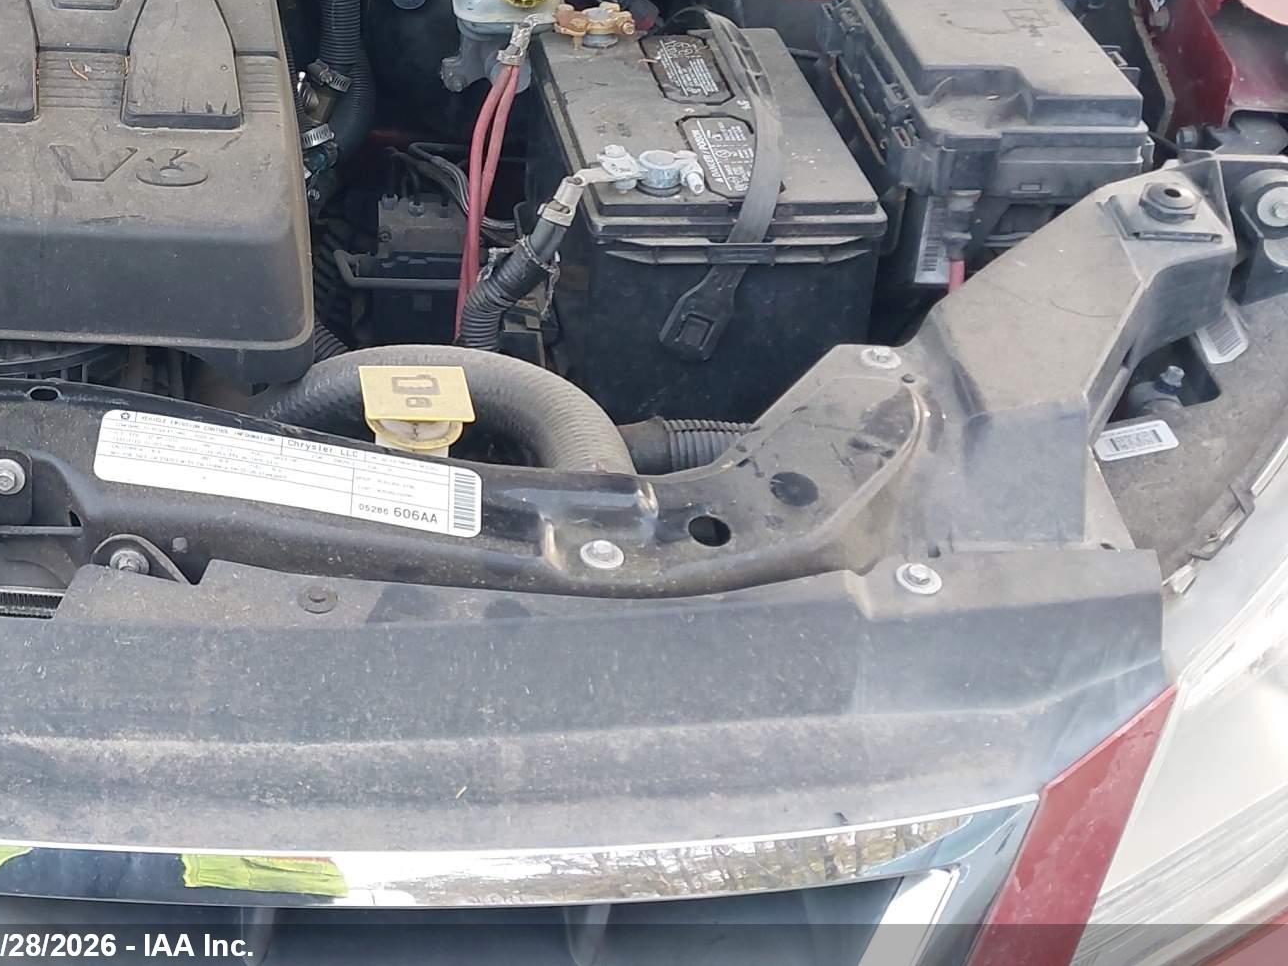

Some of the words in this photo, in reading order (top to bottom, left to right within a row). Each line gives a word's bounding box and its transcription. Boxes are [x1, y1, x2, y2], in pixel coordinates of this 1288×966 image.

[49, 142, 209, 188] V6
[287, 439, 333, 453] Chrysler
[340, 449, 359, 458] LLC
[393, 507, 438, 524] 606AA
